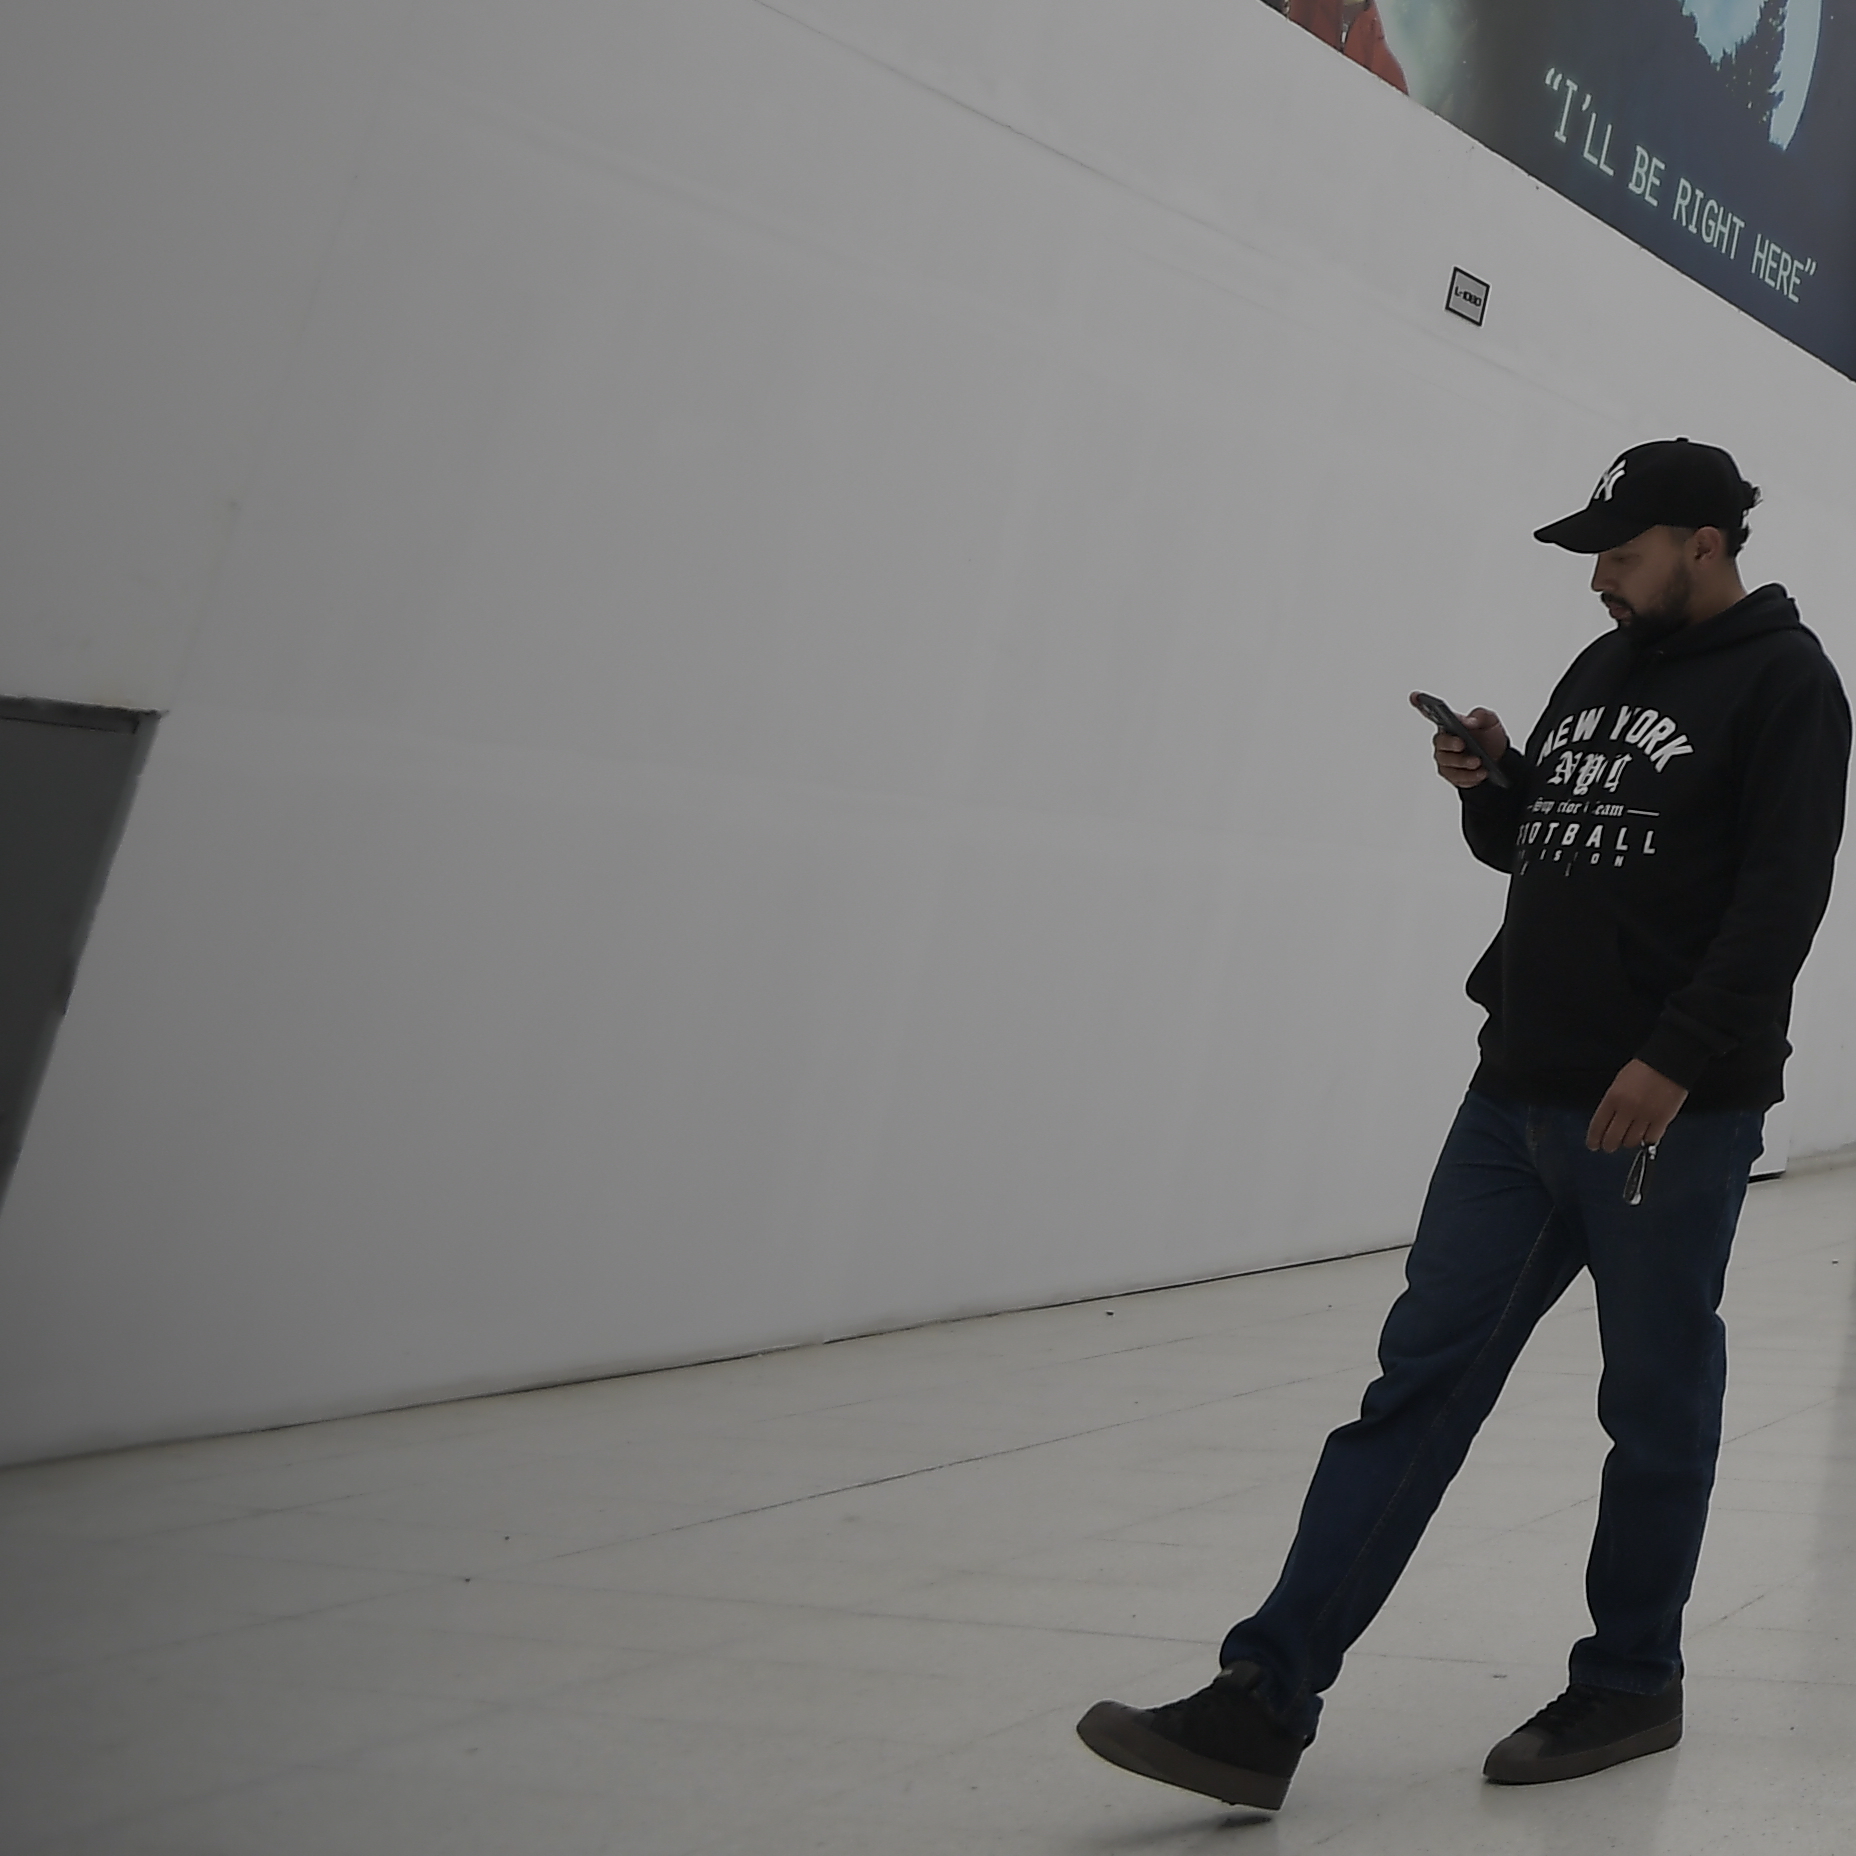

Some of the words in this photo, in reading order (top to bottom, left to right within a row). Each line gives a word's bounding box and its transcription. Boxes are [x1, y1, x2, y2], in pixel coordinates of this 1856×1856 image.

[1545, 67, 1615, 177] "I'LL
[1628, 145, 1666, 208] BE
[1672, 177, 1746, 261] RIGHT
[1751, 233, 1818, 304] HERE"
[1609, 704, 1695, 774] YORK
